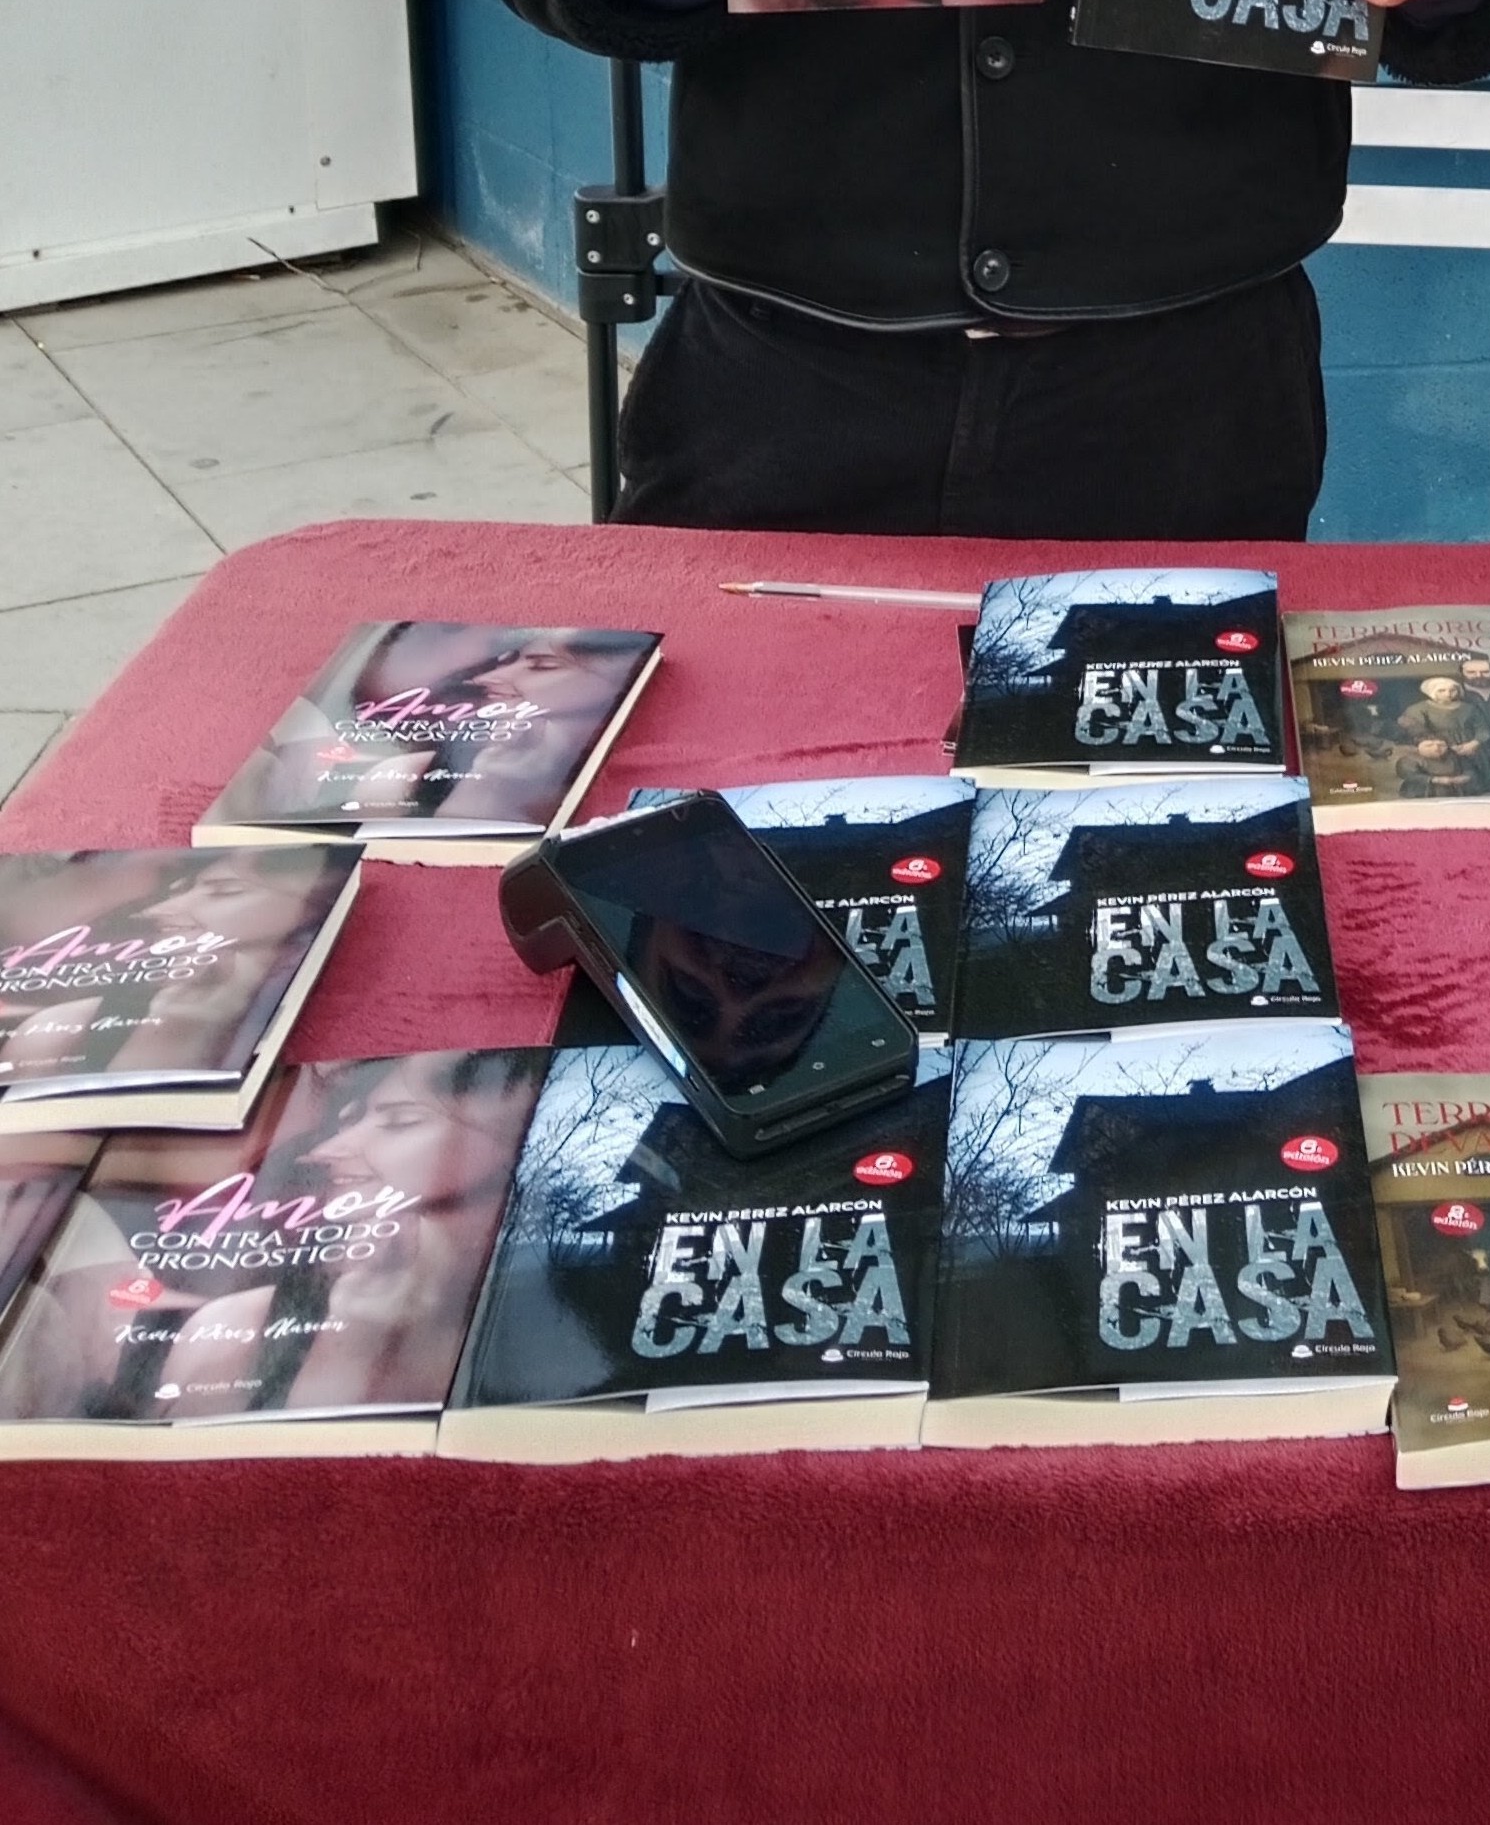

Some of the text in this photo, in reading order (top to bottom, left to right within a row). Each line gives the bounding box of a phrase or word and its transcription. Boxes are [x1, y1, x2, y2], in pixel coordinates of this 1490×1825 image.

[1080, 668, 1251, 703] EN LA
[355, 687, 551, 727] Amor
[1075, 694, 1271, 745] CASA
[335, 718, 533, 732] CONTRA TODO
[838, 894, 914, 908] ALARCÓN
[1097, 885, 1276, 908] KEVIN PÉREZ ALARCÓN
[1091, 898, 1292, 950] EN LA
[0, 925, 239, 975] Amor
[0, 953, 218, 981] ONTRA TODO
[1090, 936, 1320, 1005] CASA
[1392, 1160, 1450, 1179] KEVIN
[155, 1173, 421, 1249] Amor
[666, 1198, 882, 1224] KEVIN PÉREZ ALARCÓN
[1106, 1186, 1317, 1211] KEVIN PÉREZ ALARCÓN
[130, 1221, 401, 1250] CONTRA TODO
[646, 1215, 894, 1284] EN LA
[1098, 1201, 1339, 1273] EN LA
[137, 1241, 377, 1271] PRONÓSTICO
[630, 1268, 911, 1359] CASA
[1098, 1256, 1375, 1351] CASA
[115, 1323, 187, 1345] Kevin
